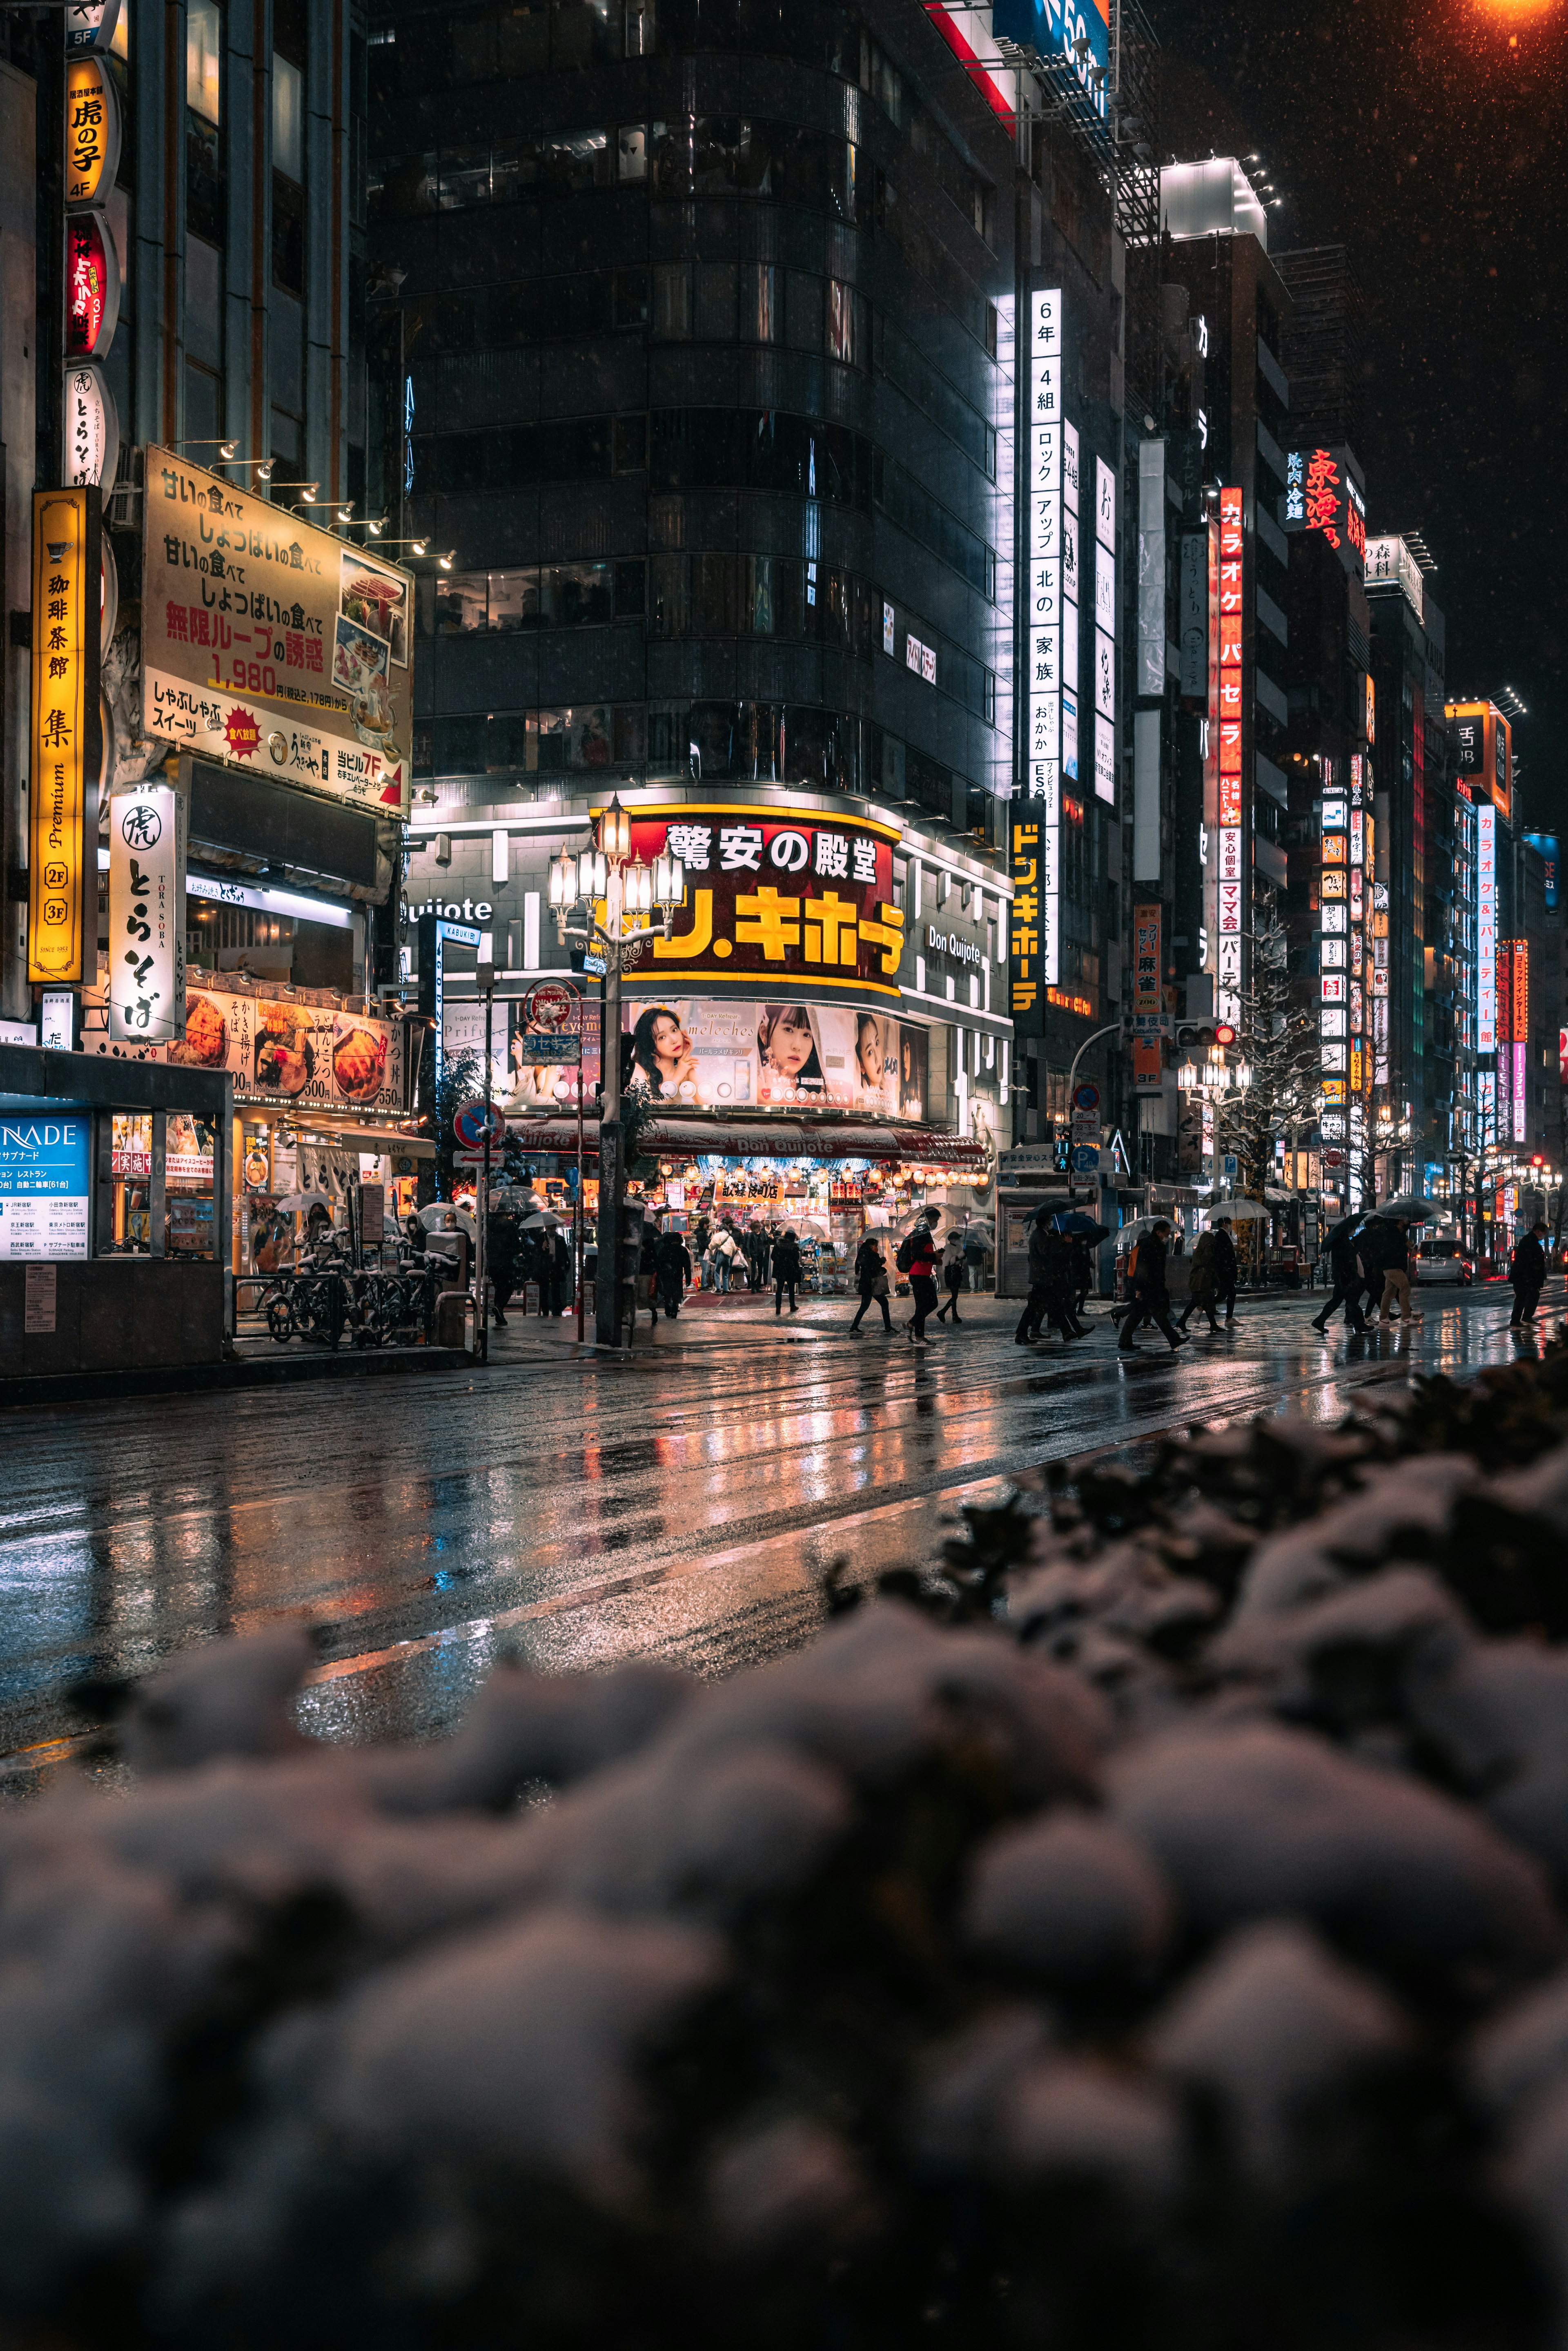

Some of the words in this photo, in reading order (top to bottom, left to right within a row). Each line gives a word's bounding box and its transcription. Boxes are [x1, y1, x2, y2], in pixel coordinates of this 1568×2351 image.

[74, 31, 91, 44] 5F
[70, 86, 103, 100] 居酒屋本舗
[71, 100, 102, 172] 虎の子
[70, 183, 90, 197] 4F
[93, 298, 100, 329] 3F
[74, 398, 90, 485] とらそば
[161, 468, 244, 521] 甘いの食べて
[1037, 432, 1055, 549] ロックアップ
[164, 534, 245, 584] 甘いの食べて
[199, 513, 321, 575] しょっぱいの食べて
[201, 578, 323, 635] しょっぱいの食べて
[1221, 503, 1242, 744] カラオケパセラ
[47, 574, 70, 680] 珈琲茶館
[165, 600, 323, 673] 無限ループの誘惑
[1036, 571, 1054, 681] 北の家族
[154, 681, 221, 722] しゃぶしゃぶ
[41, 709, 73, 748] 集
[152, 707, 196, 738] スイーツ
[229, 727, 257, 742] 食べ放題
[1035, 706, 1047, 750] おかか
[323, 755, 328, 776] 本店
[337, 750, 381, 777] 当ビル7F
[337, 769, 381, 791] 右手エレベーターより
[49, 763, 64, 849] Premium
[353, 784, 367, 796] どうぞ
[1231, 780, 1240, 800] 名物
[125, 806, 158, 848] 虎
[667, 824, 876, 885] 驚安の殿堂
[1225, 831, 1236, 877] 安心個室
[48, 869, 64, 882] 2F
[192, 882, 219, 898] お好み焼き
[47, 905, 64, 919] 3F
[1223, 885, 1238, 930] ママ会
[124, 858, 160, 1028] とらそば
[929, 925, 947, 952] Don
[949, 933, 980, 965] Quijote
[1138, 927, 1147, 954] セット
[1148, 924, 1157, 952] フリー
[1138, 956, 1156, 993] 麻雀
[1222, 940, 1239, 1018] パーティー
[230, 1001, 240, 1033] そば
[240, 1000, 251, 1067] かき揚げ
[688, 1021, 754, 1036] meleches
[322, 1014, 331, 1079] とんこつ
[390, 1024, 401, 1085] かつ丼
[699, 1048, 744, 1056] パールラメがキラリ
[256, 1085, 265, 1094] Pork
[266, 1086, 276, 1095] bone
[305, 1079, 330, 1100] 500円
[1137, 1074, 1156, 1083] 3F
[379, 1087, 402, 1107] 550円
[737, 1139, 769, 1152] Don
[775, 1139, 834, 1157] Quijote
[1078, 1152, 1088, 1168] P
[17, 1181, 69, 1189] 自動二輪車[61台]
